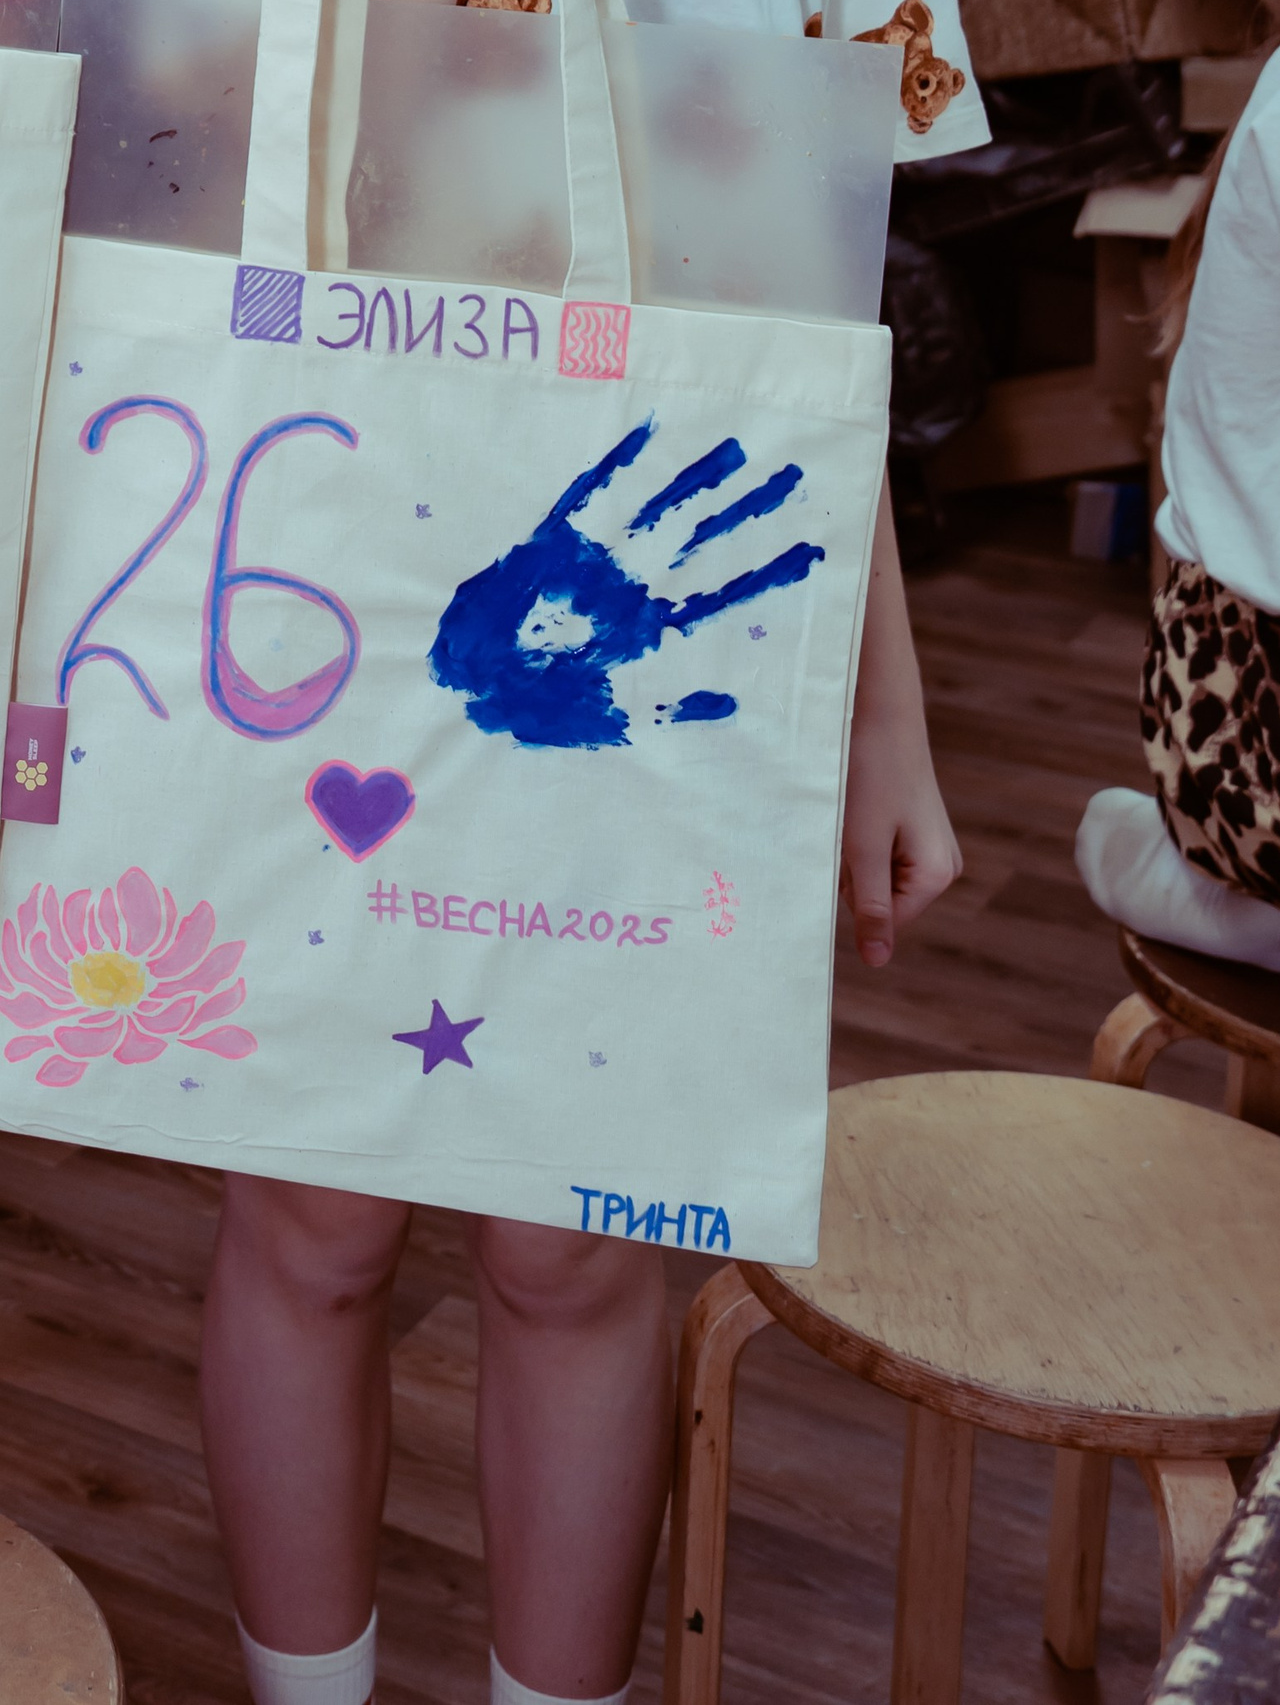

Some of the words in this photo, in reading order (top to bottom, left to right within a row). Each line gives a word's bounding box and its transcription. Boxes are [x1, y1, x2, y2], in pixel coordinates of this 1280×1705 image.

[317, 282, 540, 360] ЭЛИЗА
[55, 394, 362, 743] 26
[570, 1185, 732, 1253] ТРИНТА
